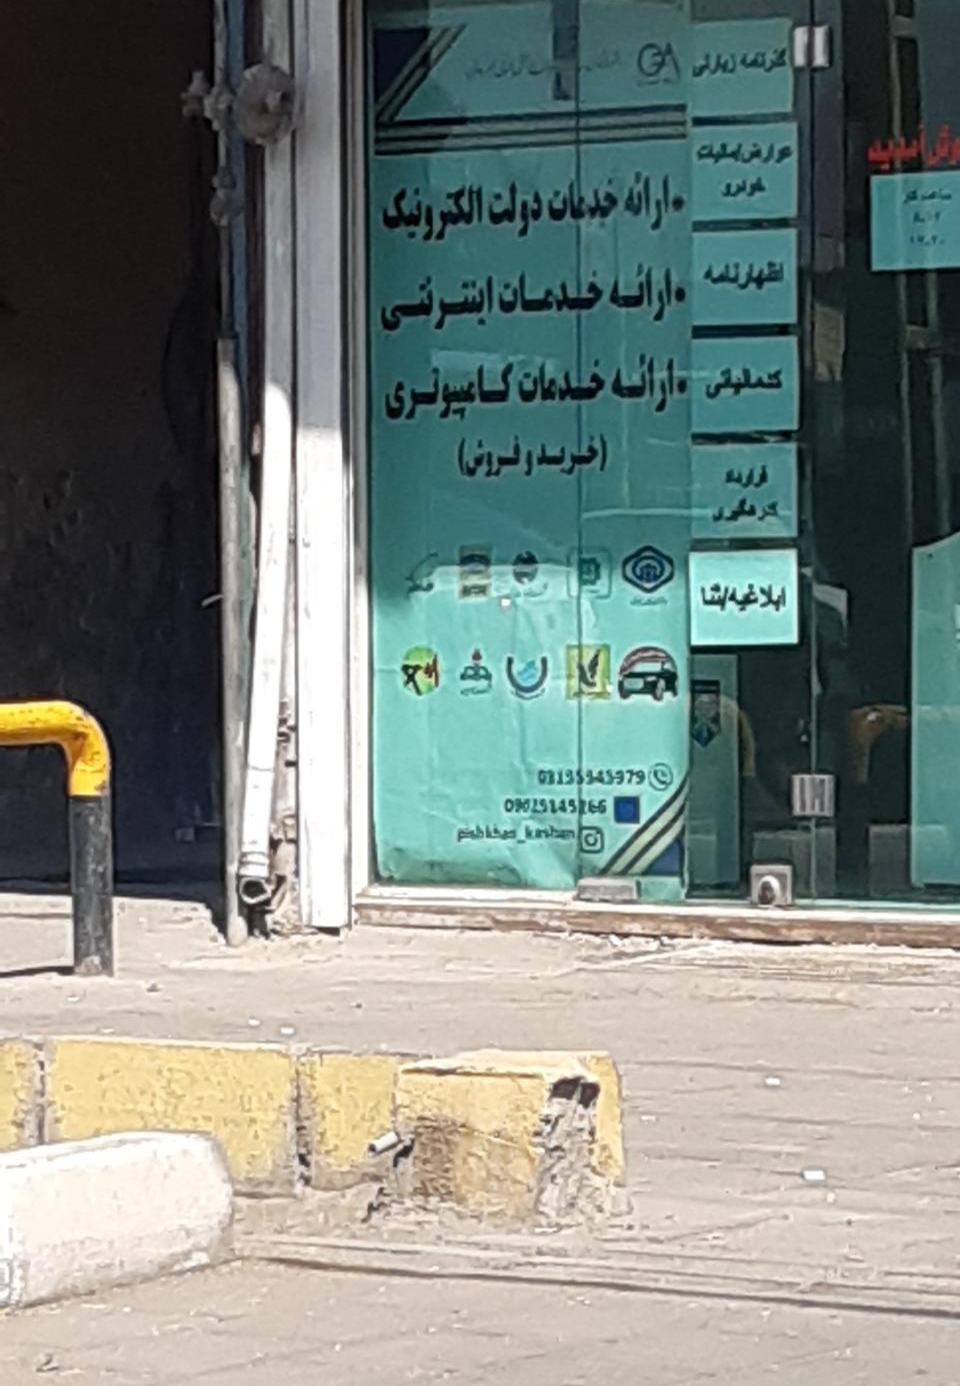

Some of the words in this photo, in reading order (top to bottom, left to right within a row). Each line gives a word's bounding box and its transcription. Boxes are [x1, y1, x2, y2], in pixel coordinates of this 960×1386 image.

[488, 181, 542, 237] دولت
[548, 178, 618, 226] خدمات
[624, 172, 671, 230] ارائه
[722, 176, 767, 197] خودرو
[382, 185, 484, 240] الکترونیک
[499, 271, 603, 314] خدمات
[610, 263, 671, 321] ارائه
[703, 261, 784, 291] اظهارنامه
[381, 274, 493, 330] اینترنتی
[385, 363, 514, 419] کامپیوتری
[518, 359, 605, 403] خدمات
[612, 353, 674, 412] ارائه
[525, 449, 534, 475] و
[725, 465, 768, 489] قرارداد
